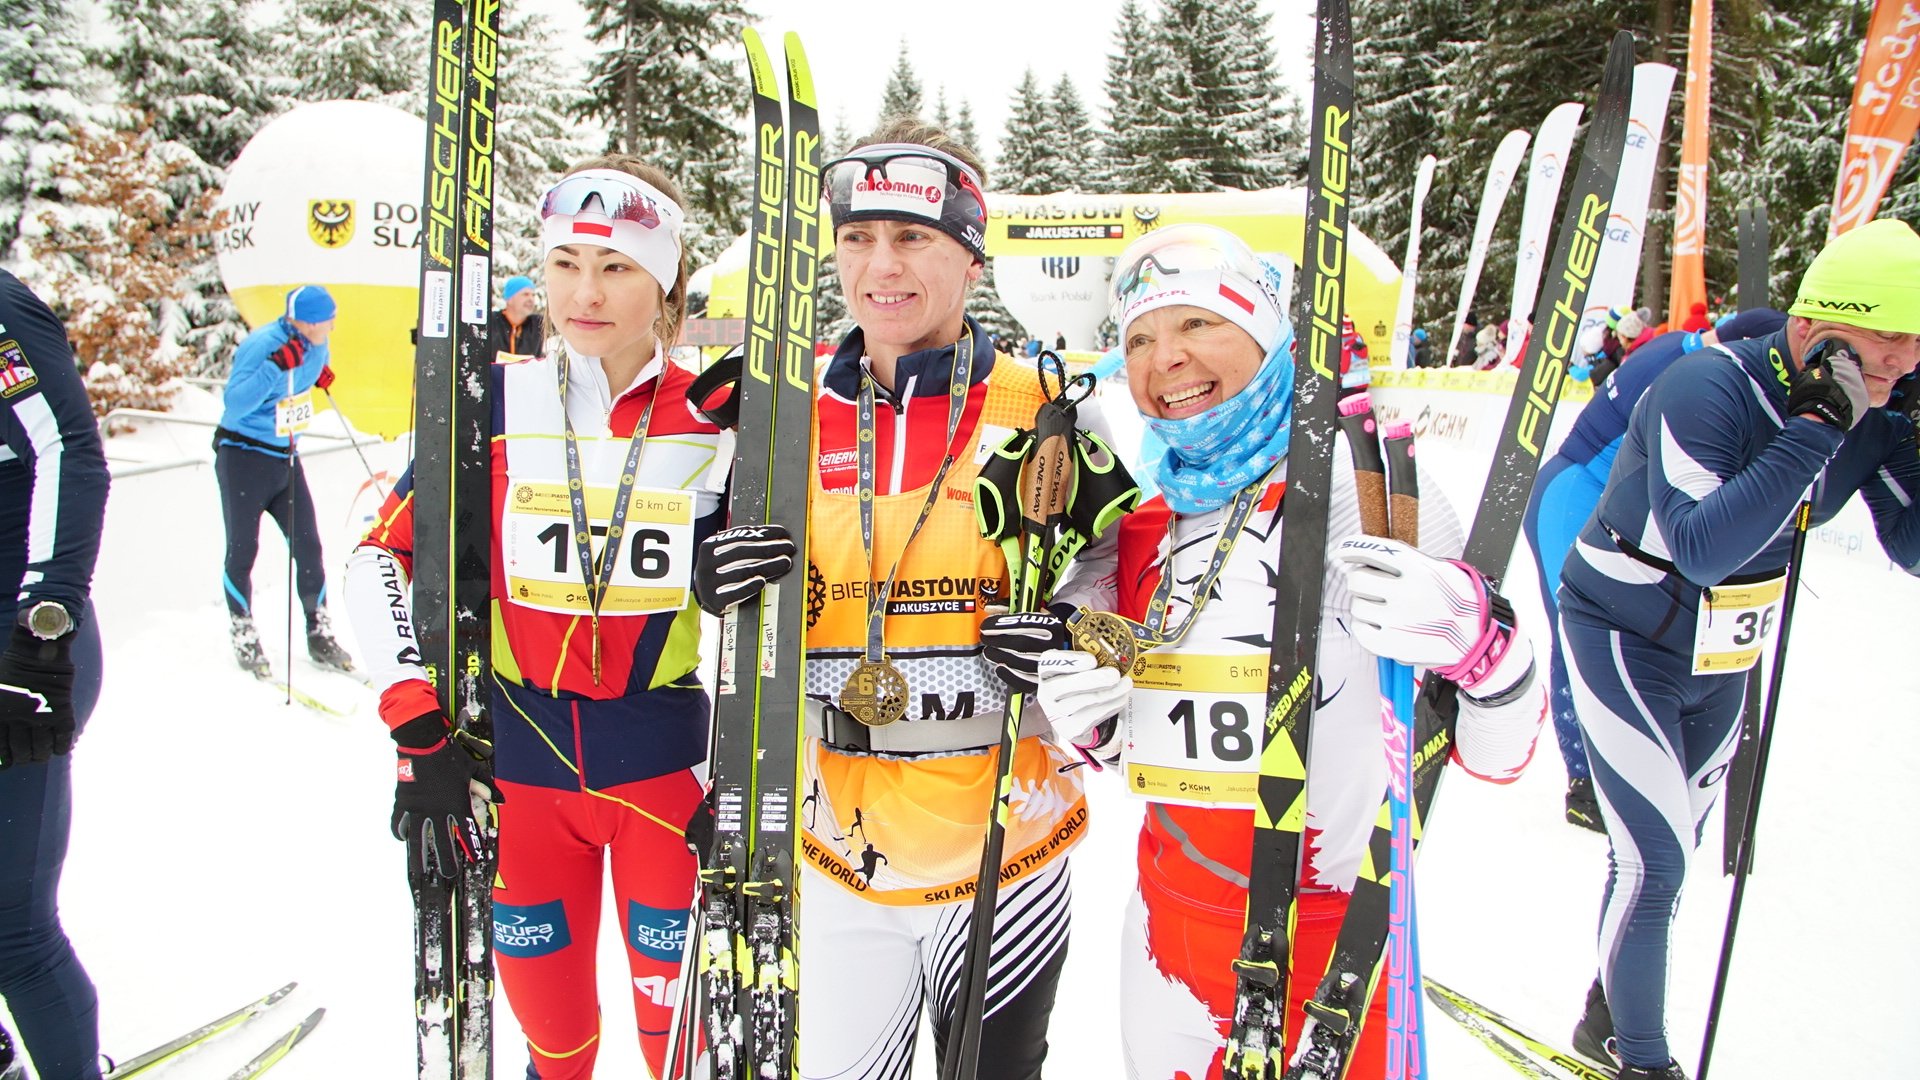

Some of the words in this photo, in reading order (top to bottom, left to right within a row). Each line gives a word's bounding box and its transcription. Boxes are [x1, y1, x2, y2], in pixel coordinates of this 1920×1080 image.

[429, 20, 461, 268] FISCHER
[1625, 133, 1647, 149] GE
[374, 202, 422, 223] DO
[1025, 226, 1106, 239] JAKUSZYCE
[1310, 105, 1349, 381] FISCHER
[1604, 227, 1631, 243] GE
[750, 123, 782, 385] FISCHER
[786, 130, 818, 392] FISCHER
[1517, 193, 1609, 458] FISCHER
[635, 498, 644, 510] 6
[647, 500, 664, 511] km
[667, 501, 682, 512] CT
[1341, 541, 1401, 556] SWIX
[892, 602, 960, 614] JAKUSZYCE
[995, 614, 1063, 626] SWIX
[1733, 605, 1776, 646] 36
[466, 655, 481, 678] 3D
[1229, 665, 1239, 678] 6
[1243, 665, 1263, 678] km
[858, 673, 874, 695] 6
[1265, 694, 1293, 735] SPEED
[1288, 666, 1313, 703] MAX
[1168, 699, 1254, 762] 18
[1423, 728, 1450, 762] MAX
[1188, 784, 1211, 793] KGHM
[465, 816, 484, 860] REX
[924, 889, 951, 903] SKI
[954, 863, 1014, 898] ARND
[1020, 846, 1050, 869] THE
[1047, 806, 1087, 851] WORLD
[818, 854, 868, 892] WORLD
